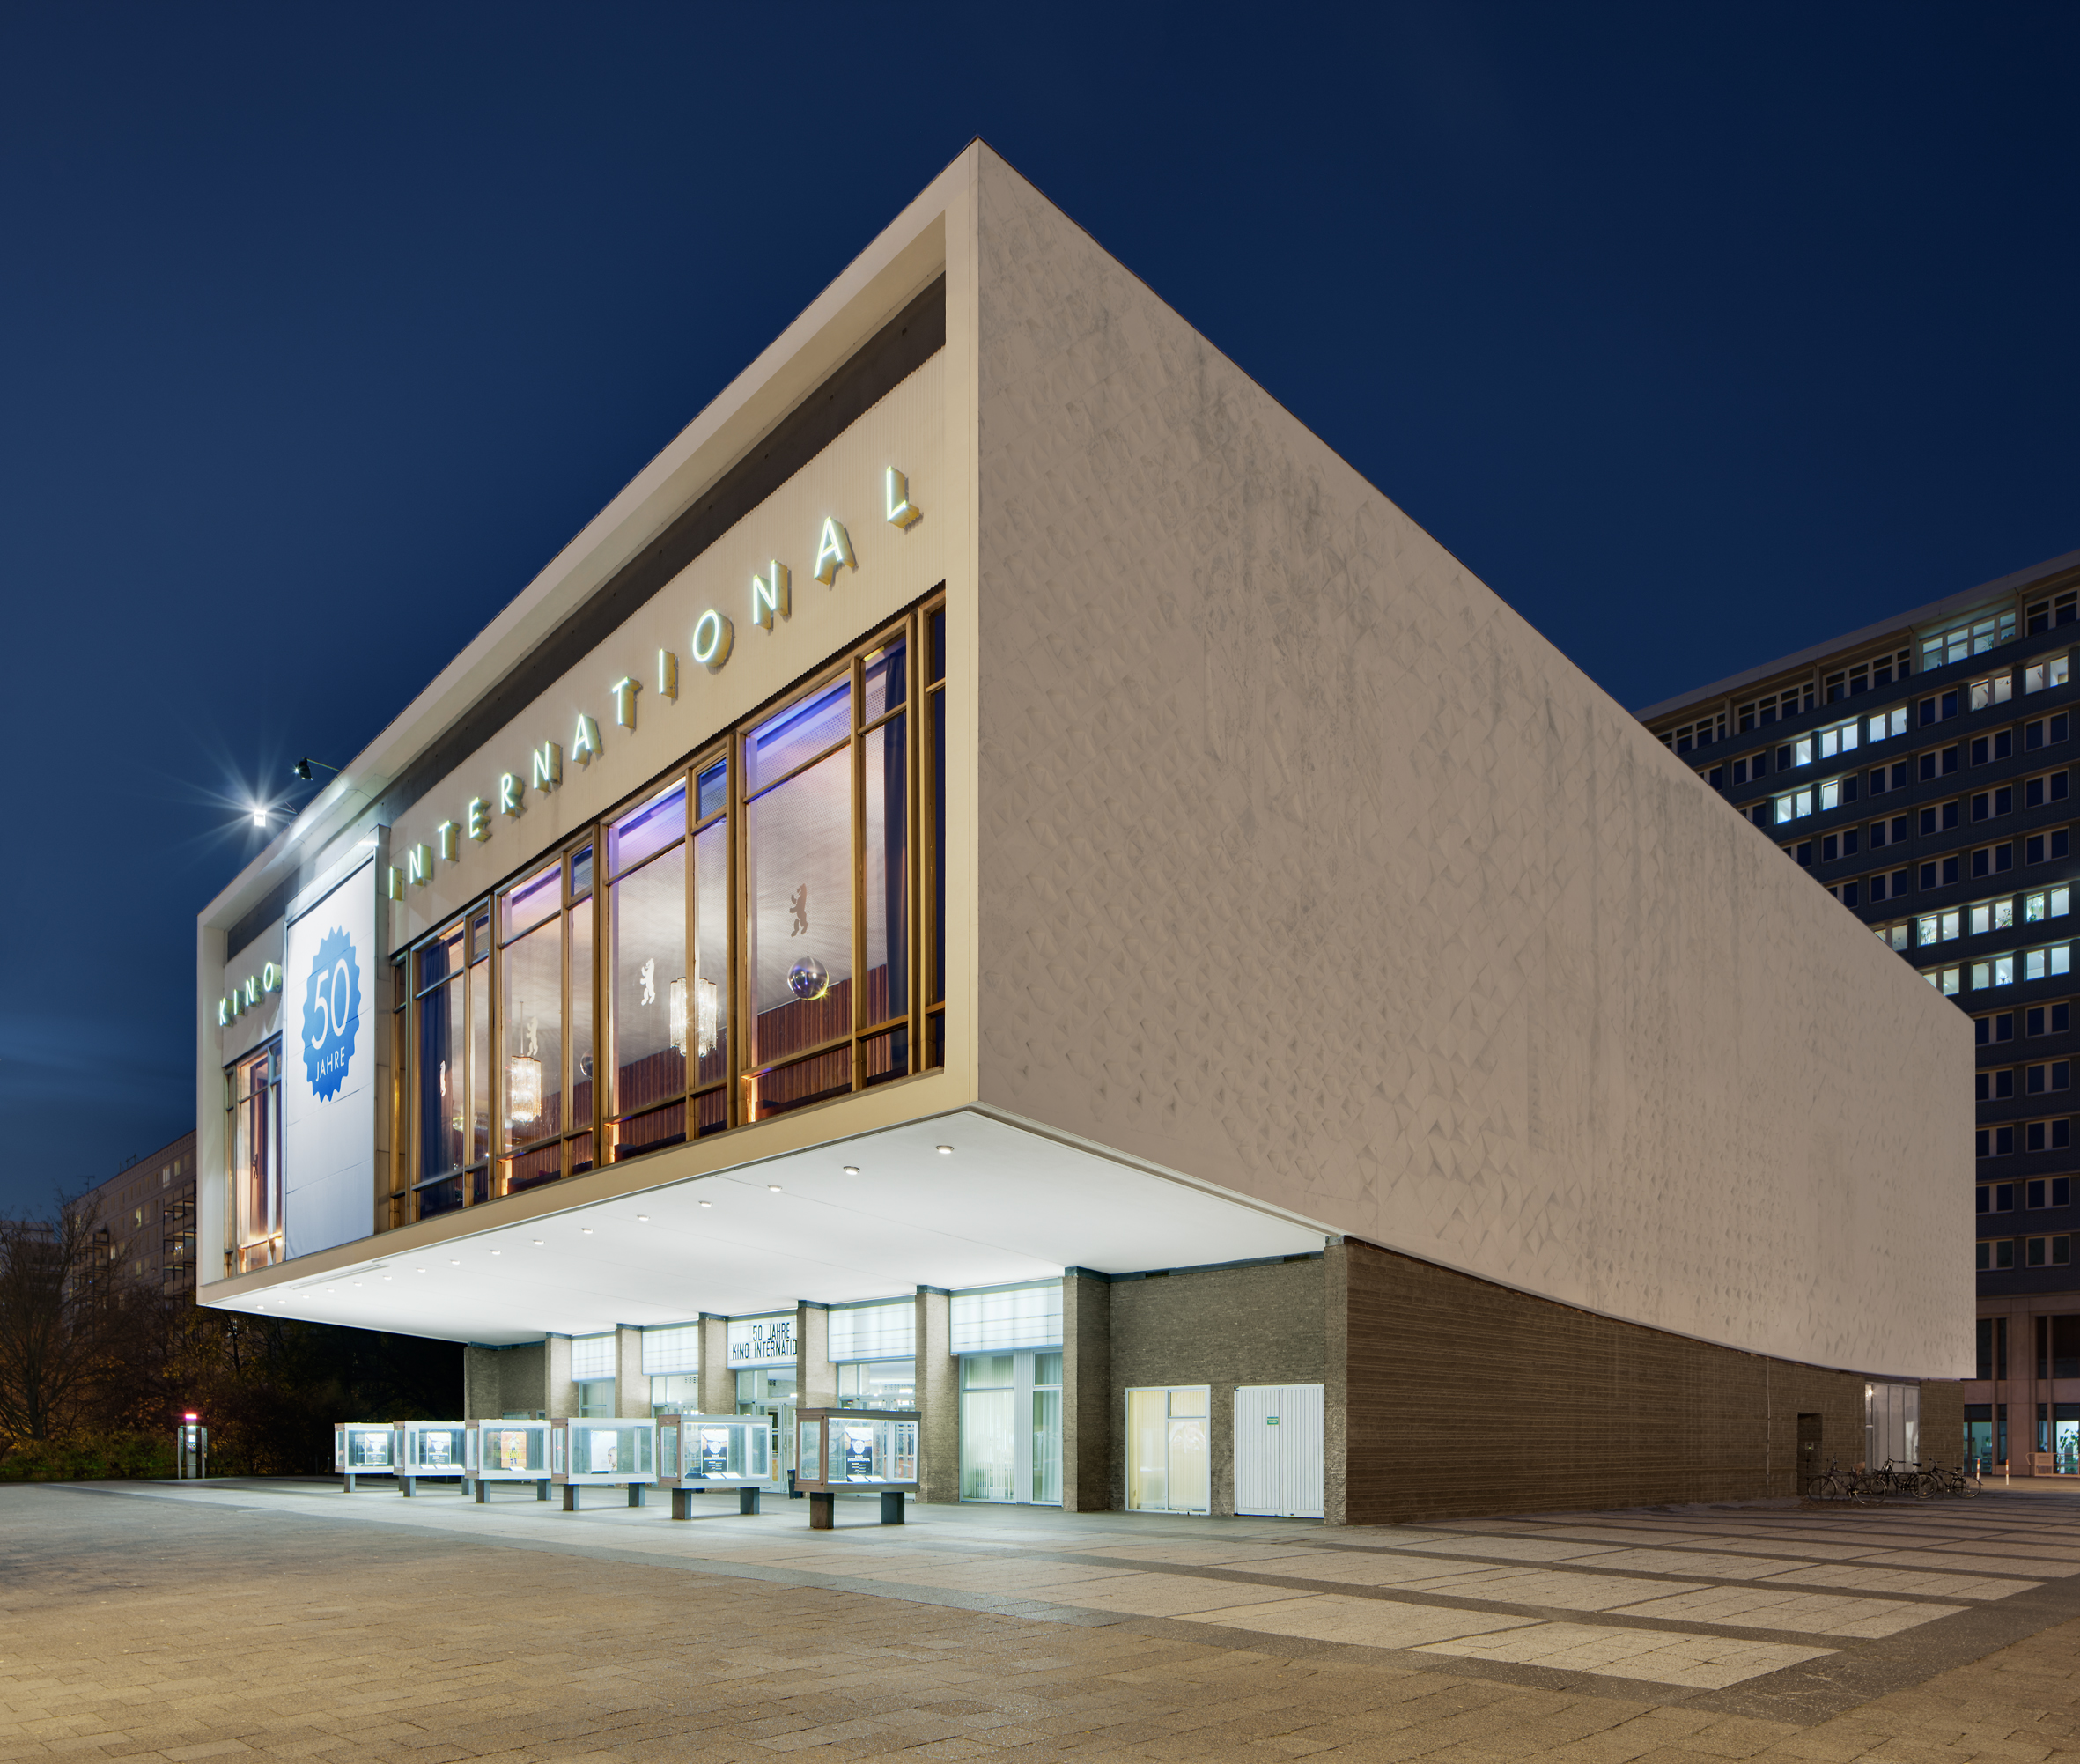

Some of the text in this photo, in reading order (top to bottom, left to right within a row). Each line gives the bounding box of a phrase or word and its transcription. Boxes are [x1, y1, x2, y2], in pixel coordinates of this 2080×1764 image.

[219, 466, 920, 1028] KINO INTERNATIONAL
[311, 958, 350, 1050] 50
[315, 1046, 345, 1082] JAHRE
[752, 1322, 790, 1341] 50 JAHRE
[732, 1342, 749, 1360] KINO
